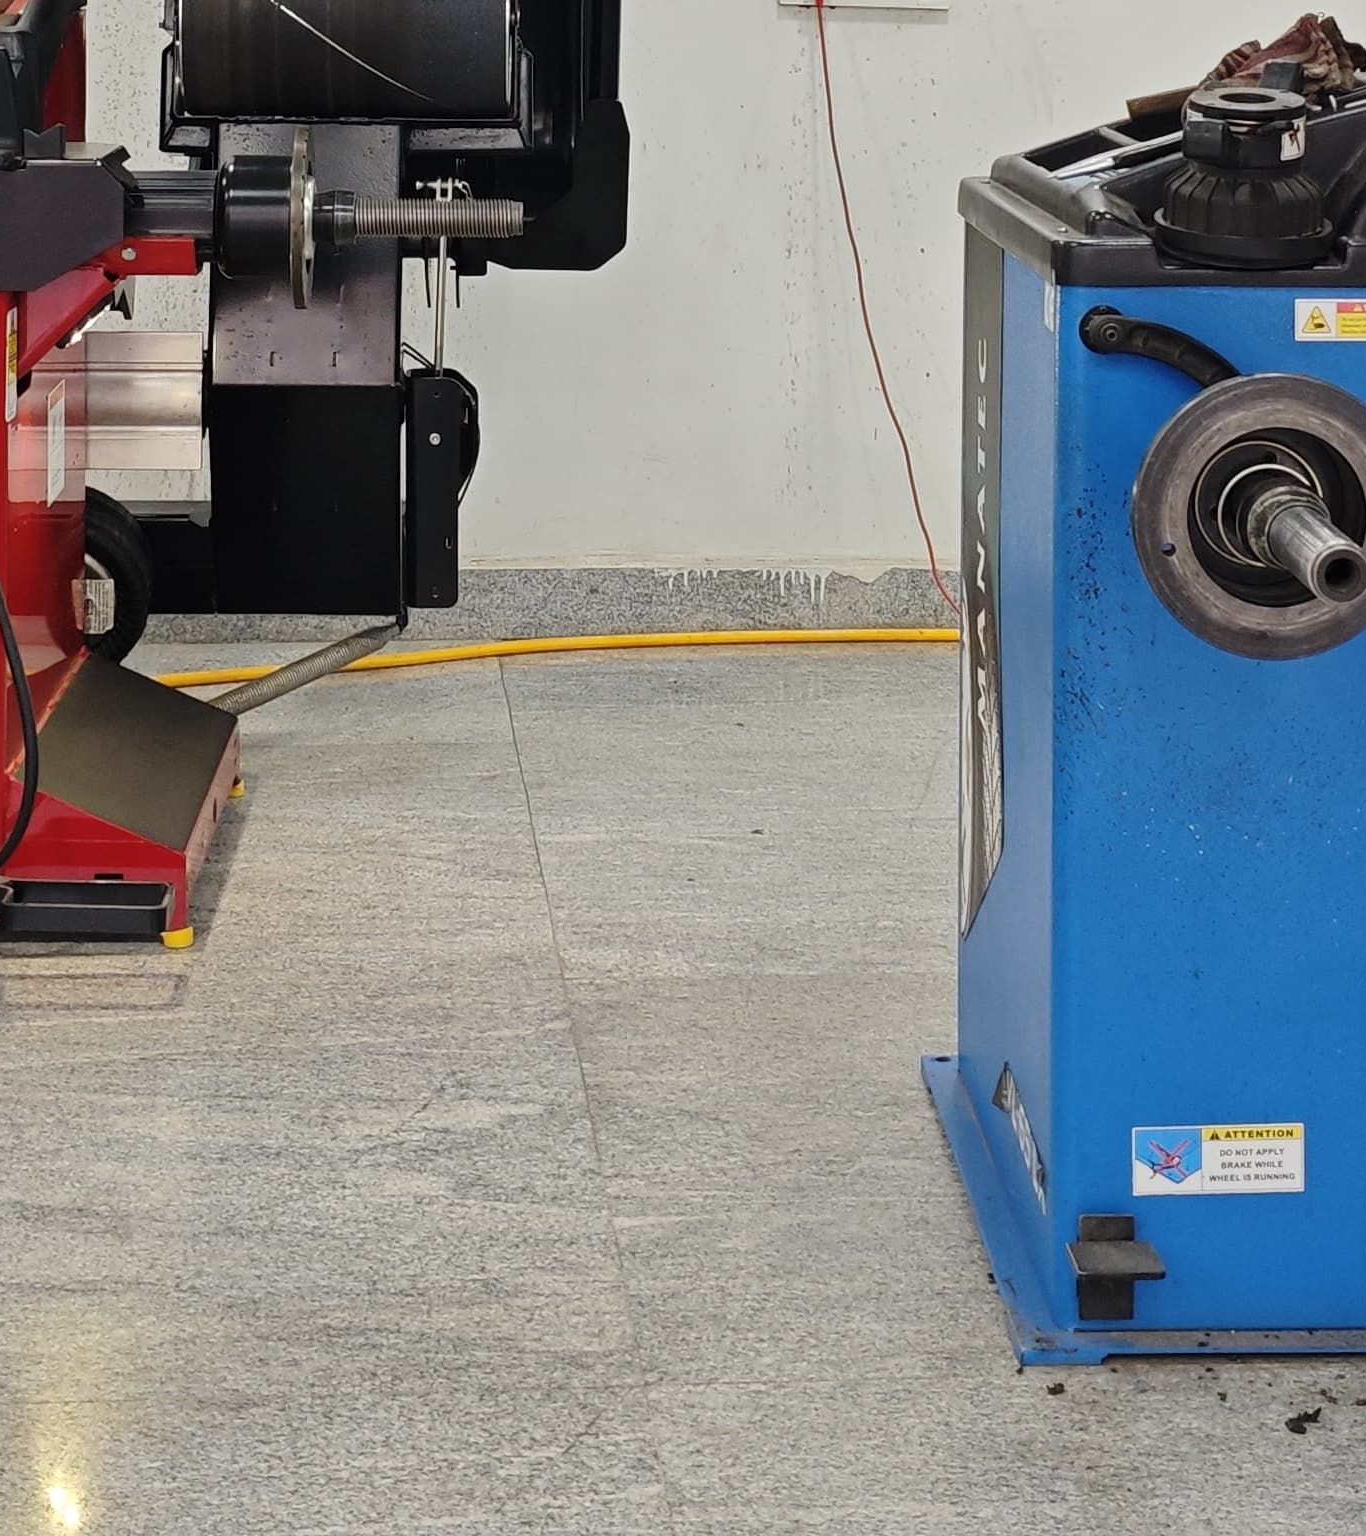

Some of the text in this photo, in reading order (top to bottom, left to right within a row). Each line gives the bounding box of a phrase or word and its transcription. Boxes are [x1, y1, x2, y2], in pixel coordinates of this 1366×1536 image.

[976, 338, 988, 731] MANATEC
[1224, 1129, 1294, 1139] ATTENTION
[1219, 1148, 1233, 1156] DO
[1235, 1148, 1253, 1156] NOT
[1209, 1173, 1295, 1182] WHEEL IS RUNNING
